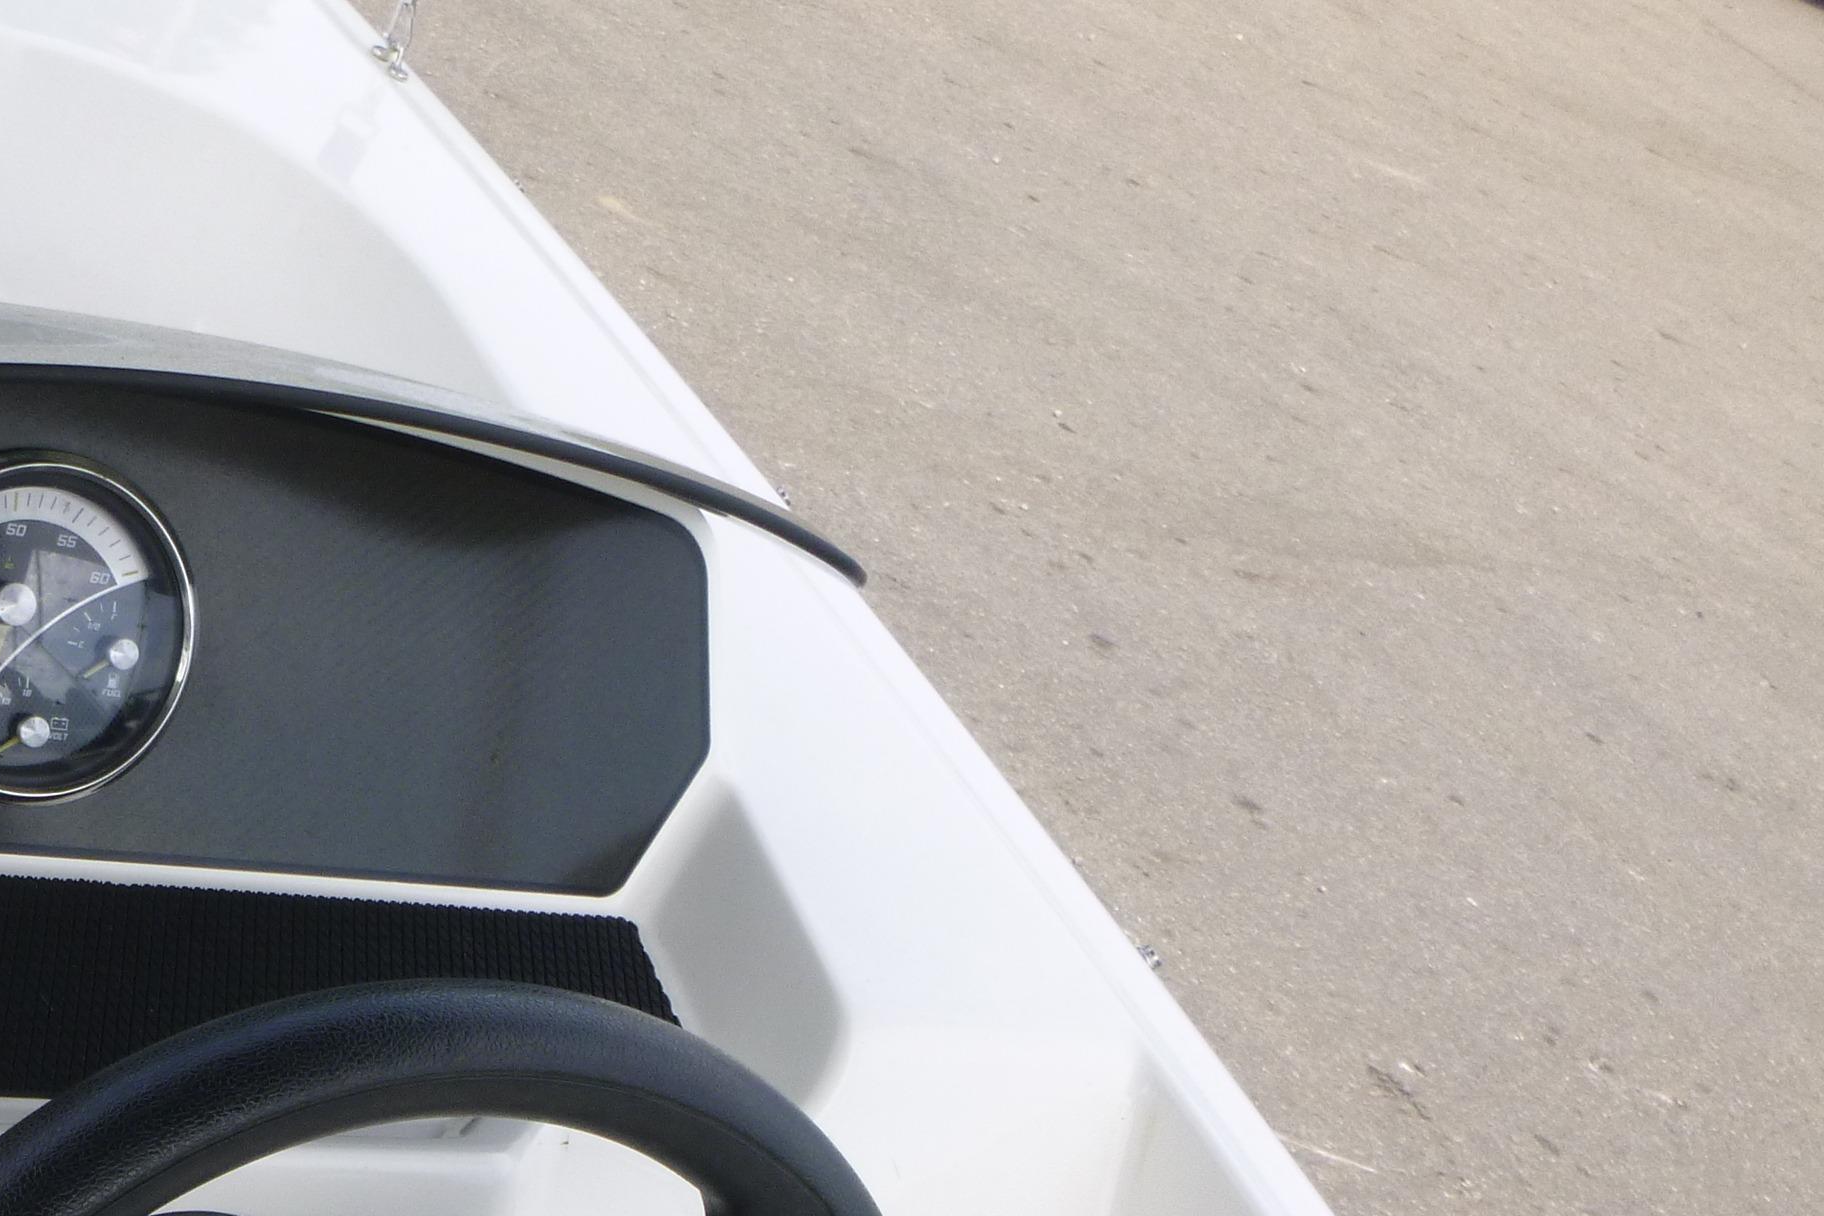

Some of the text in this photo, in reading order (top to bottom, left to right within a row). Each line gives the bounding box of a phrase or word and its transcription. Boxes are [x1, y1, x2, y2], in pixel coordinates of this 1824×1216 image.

[6, 523, 27, 537] 50
[57, 535, 77, 548] 55
[90, 571, 110, 584] 60
